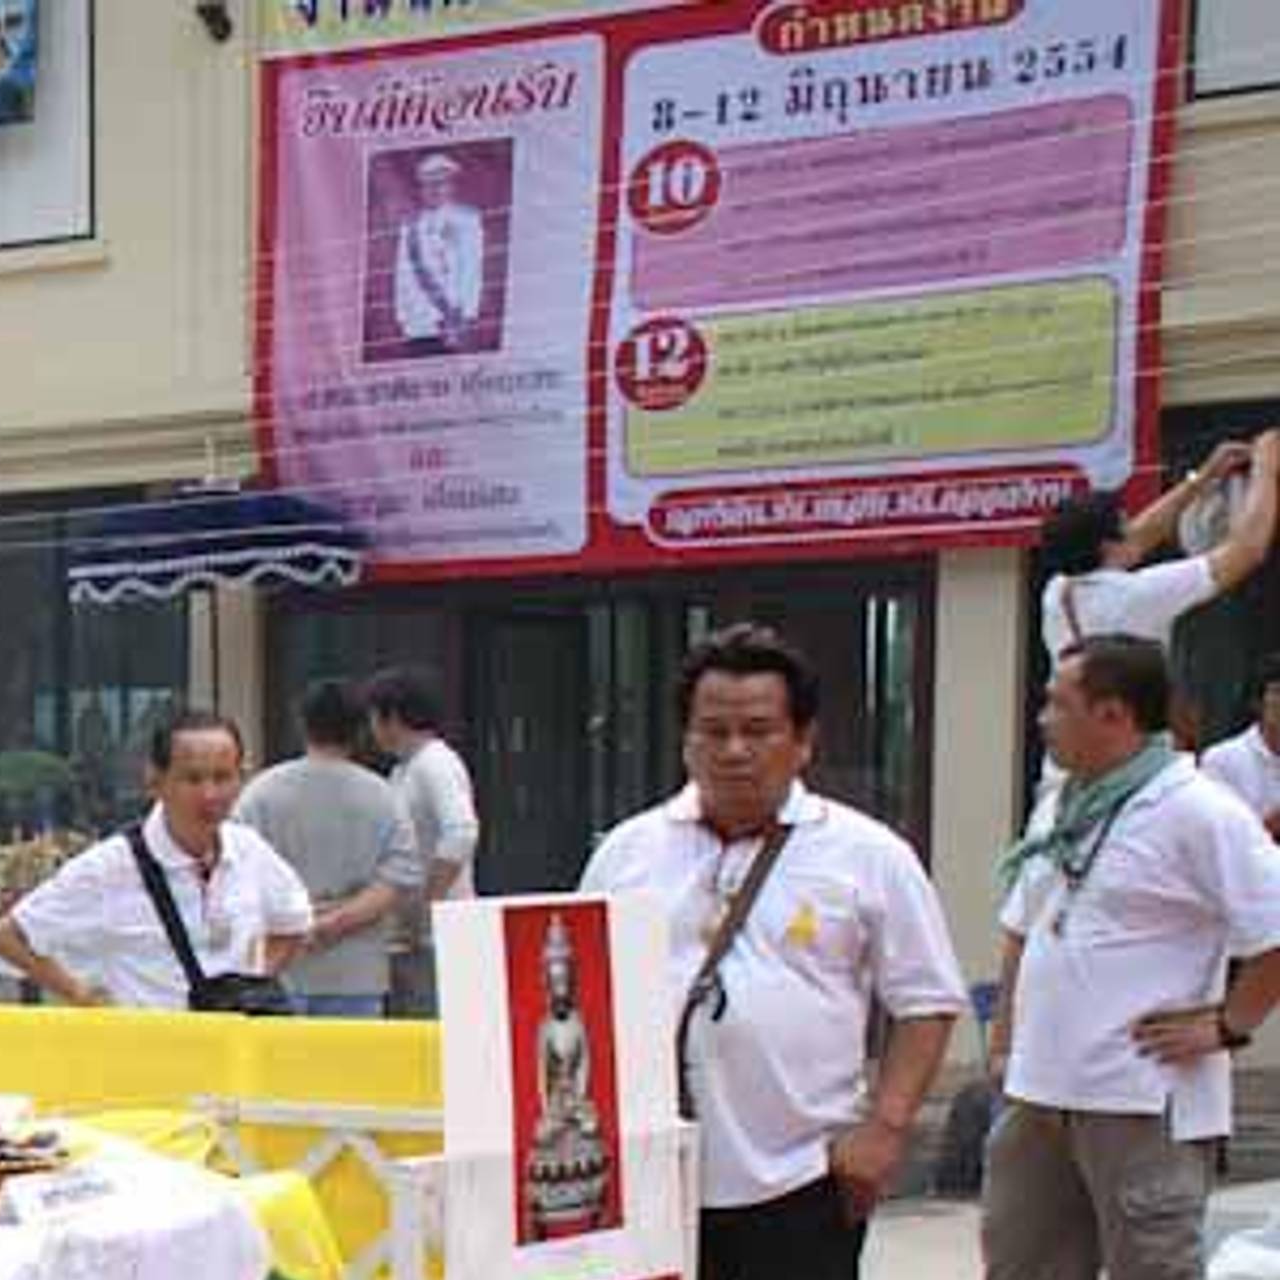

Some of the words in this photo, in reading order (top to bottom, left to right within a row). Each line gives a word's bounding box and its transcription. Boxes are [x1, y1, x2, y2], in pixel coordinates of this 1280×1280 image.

[301, 61, 578, 138] ยินดีต้อนรับ
[651, 86, 762, 132] 8-12
[783, 57, 995, 123] มิถุนายน
[1013, 33, 1130, 85] 2554
[647, 154, 706, 207] 10
[633, 327, 689, 380] 12
